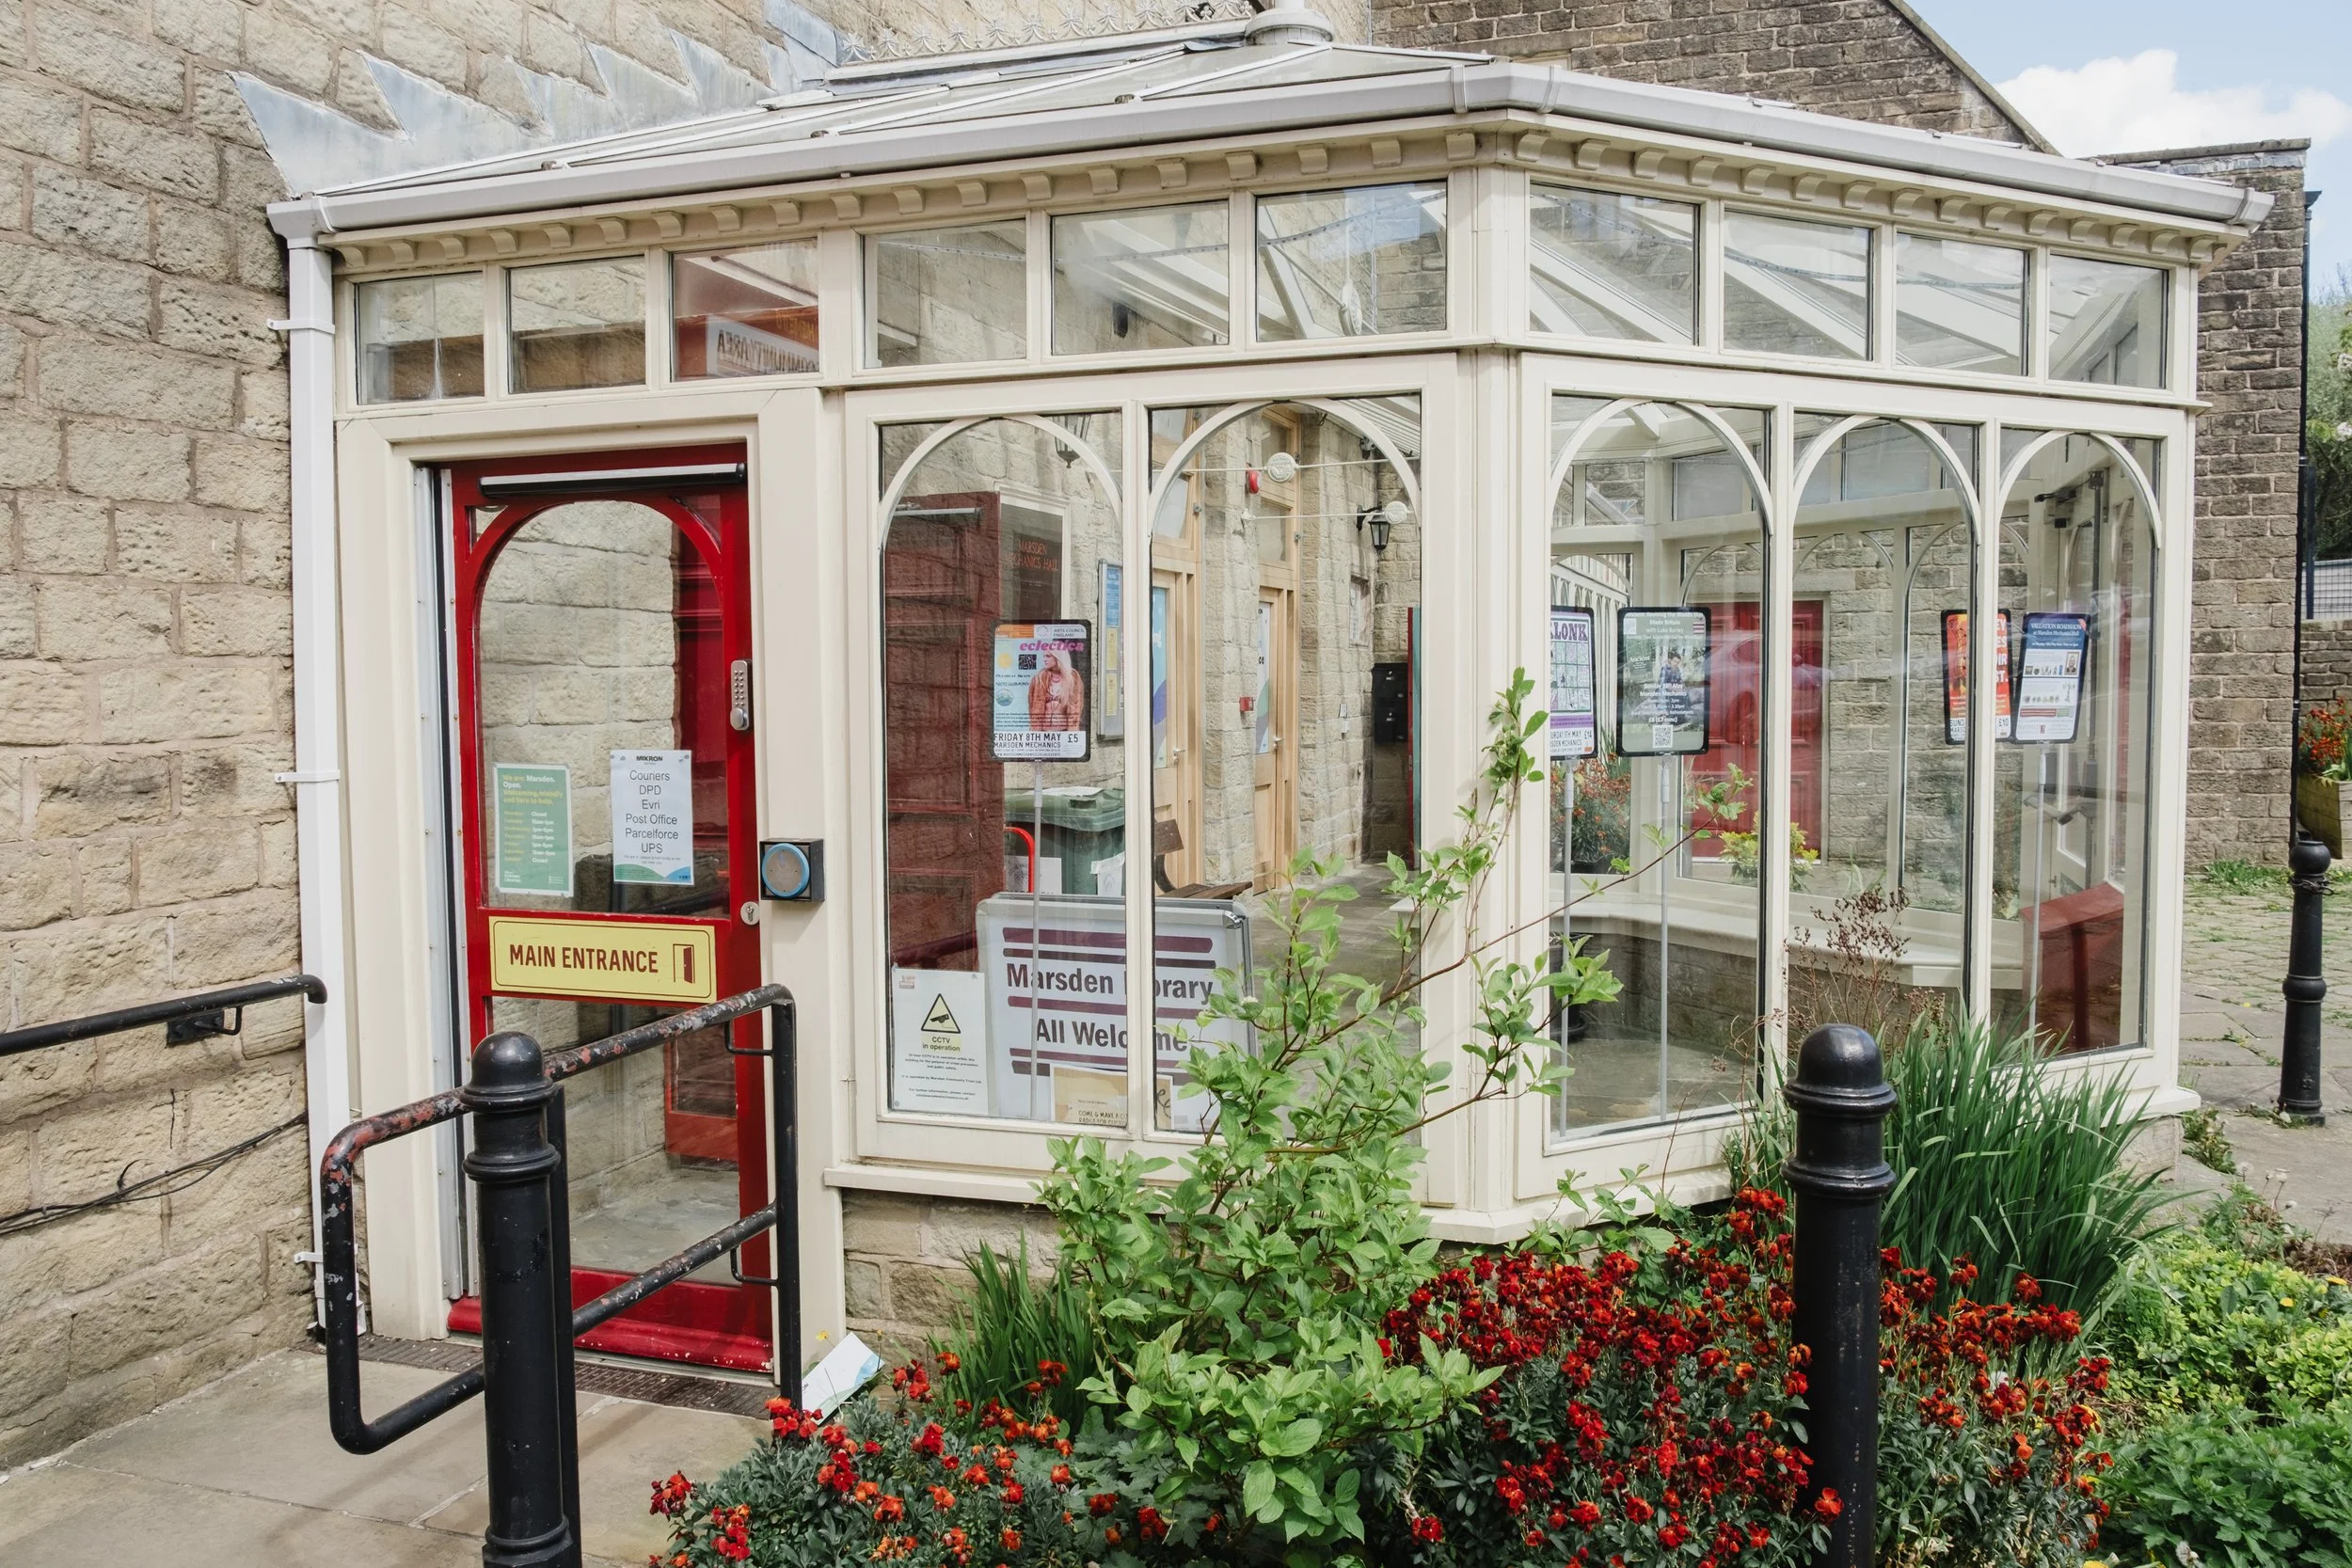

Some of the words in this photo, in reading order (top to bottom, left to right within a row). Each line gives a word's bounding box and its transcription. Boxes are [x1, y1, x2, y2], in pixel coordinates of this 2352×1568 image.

[1019, 640, 1085, 652] eclectica
[1068, 734, 1079, 743] £5
[629, 770, 671, 782] Couriers
[639, 784, 661, 796] DPD
[642, 800, 660, 810] Evri
[626, 813, 647, 825] Post
[649, 814, 677, 826] Office
[626, 828, 679, 840] Parcelforce
[641, 843, 663, 854] UPS
[509, 943, 556, 968] MAIN
[562, 946, 659, 974] ENTRANCE
[1007, 963, 1114, 994] Marsden
[1124, 971, 1214, 1006] rary
[1036, 1018, 1065, 1043] All
[1072, 1021, 1188, 1053] Welcme
[930, 1043, 961, 1052] operation
